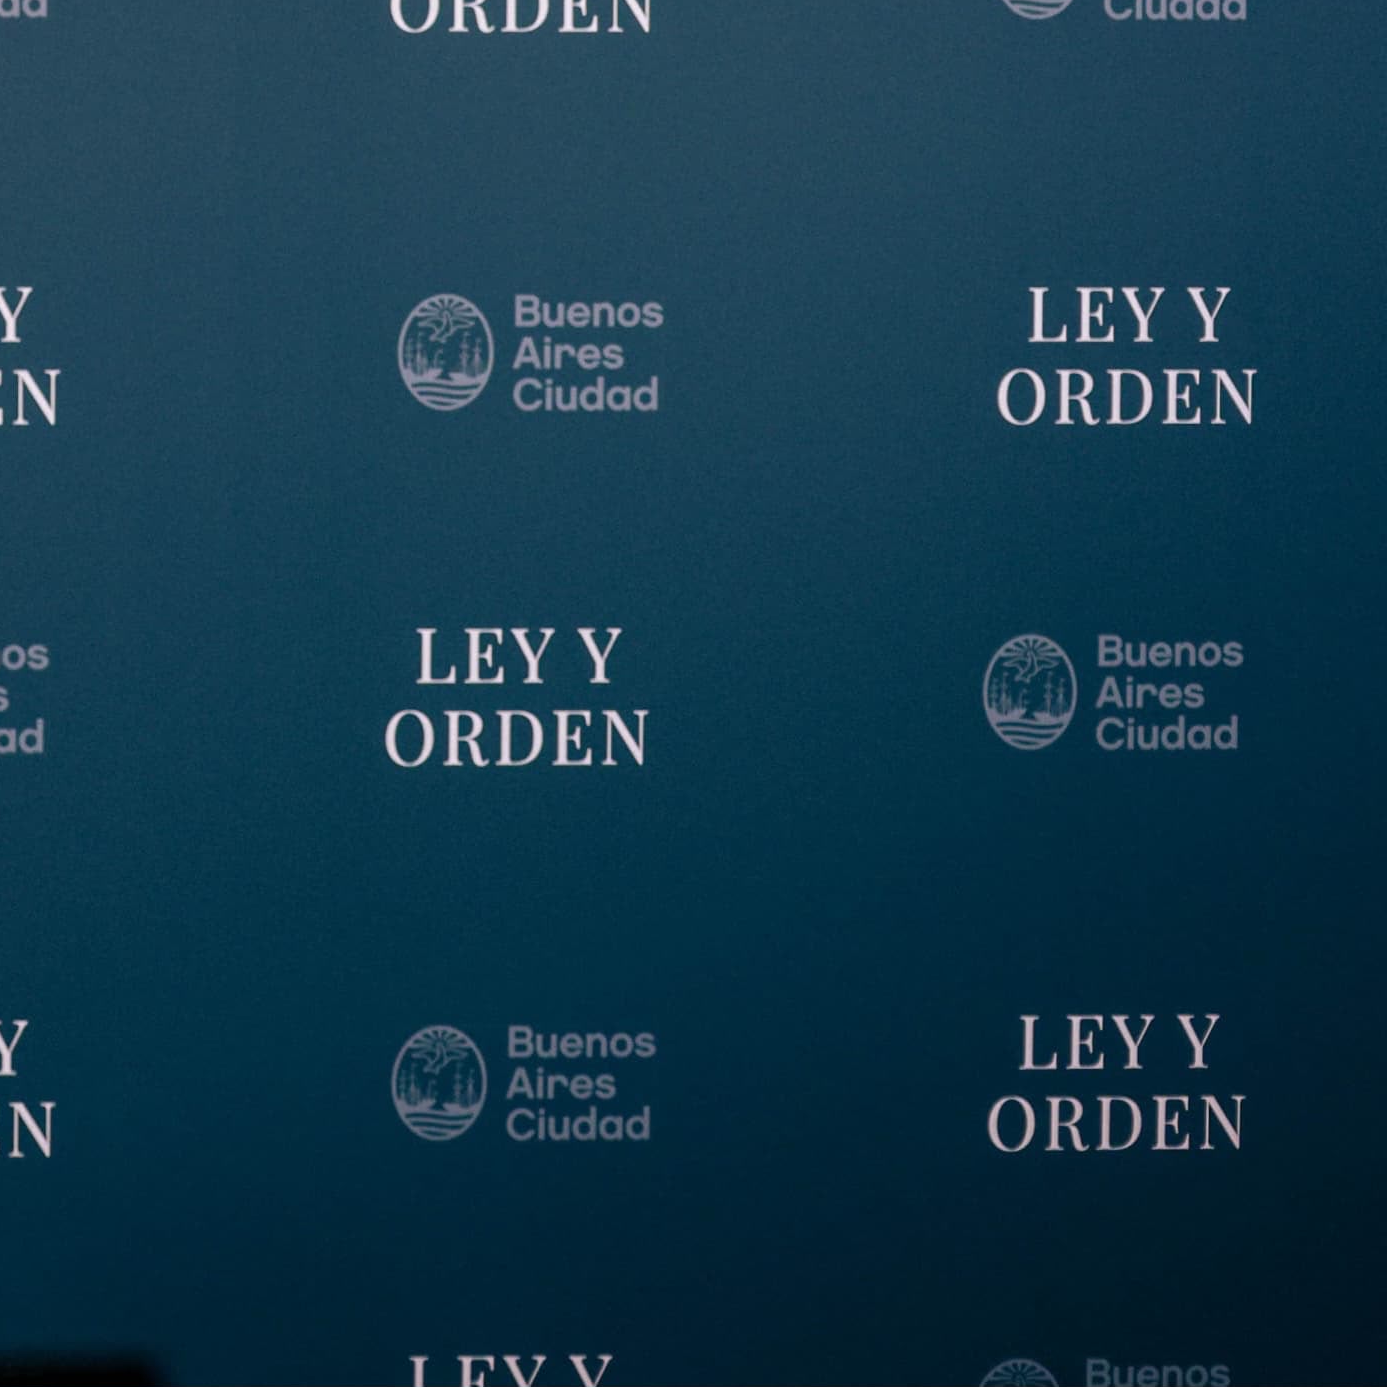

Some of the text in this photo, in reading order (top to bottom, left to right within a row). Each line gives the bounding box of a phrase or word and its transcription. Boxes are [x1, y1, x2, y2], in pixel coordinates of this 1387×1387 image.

[514, 294, 664, 328] Buenos
[1028, 286, 1231, 343] LEY Y
[512, 336, 625, 370] Aires
[512, 375, 659, 412] Ciudad
[996, 367, 1258, 426] ORDEN
[415, 626, 623, 685] LEY Y
[1098, 634, 1244, 668] Buenos
[1095, 675, 1205, 709] Aires
[383, 708, 650, 768] ORDEN
[1095, 714, 1239, 751] Ciudad
[507, 1025, 657, 1058] Buenos
[1019, 1013, 1220, 1071] LEY Y
[506, 1066, 616, 1100] Aires
[506, 1105, 650, 1141] Ciudad
[987, 1094, 1246, 1153] ORDEN
